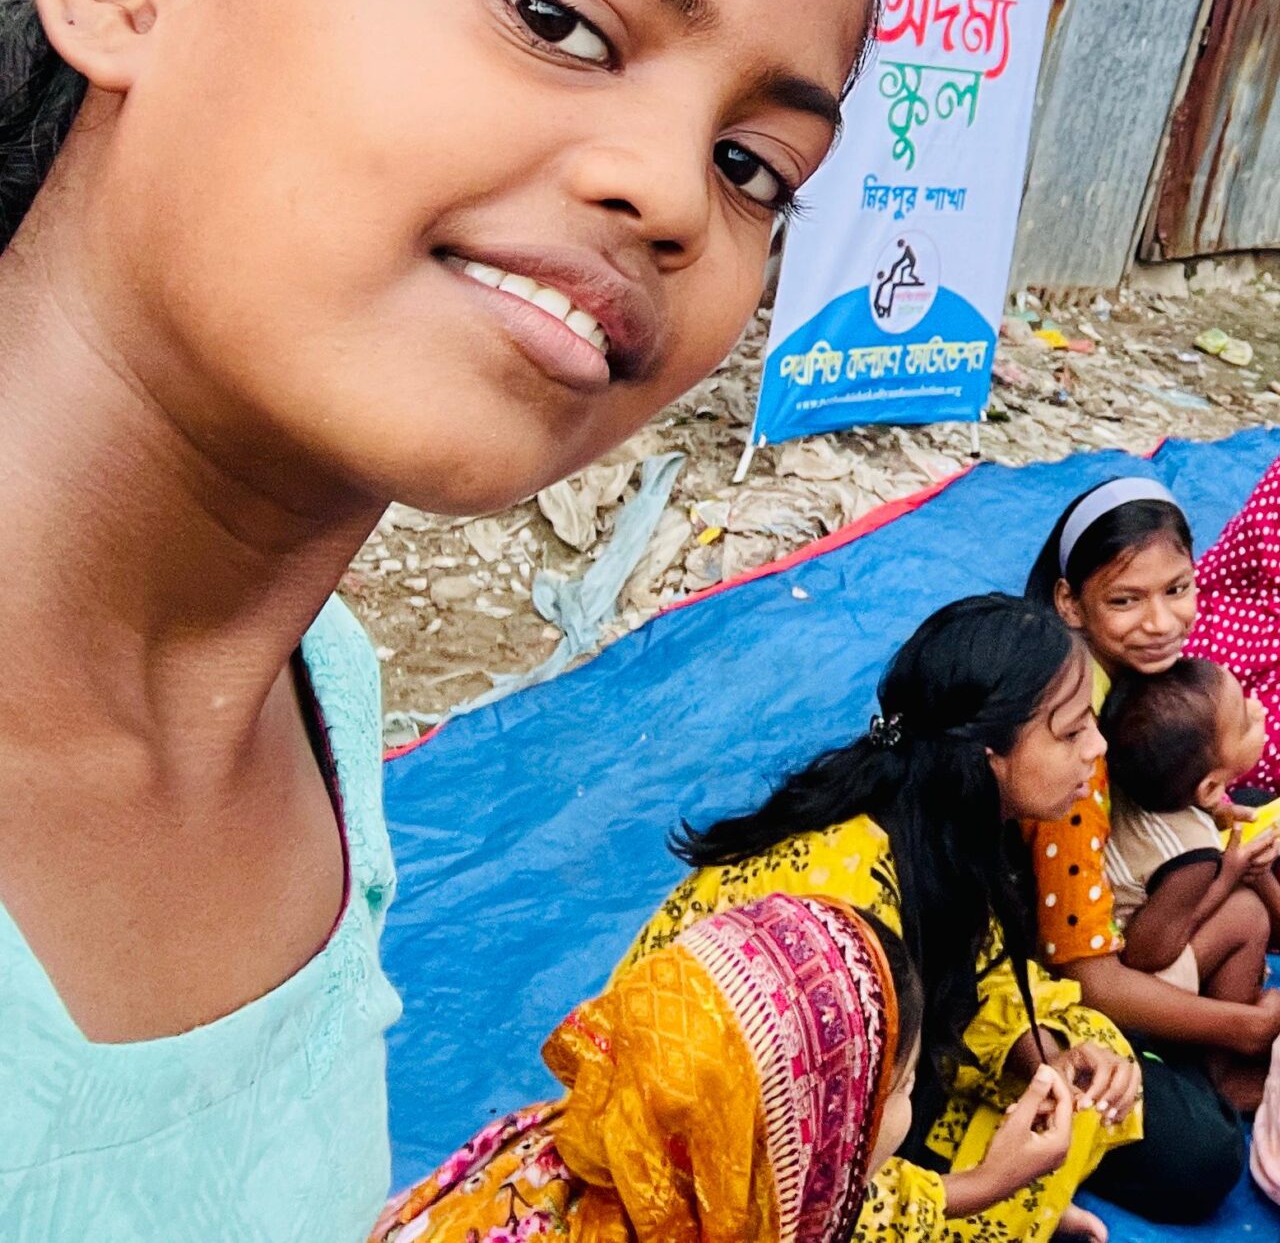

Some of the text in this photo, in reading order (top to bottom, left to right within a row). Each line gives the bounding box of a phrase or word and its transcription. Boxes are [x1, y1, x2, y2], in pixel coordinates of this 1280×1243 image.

[879, 60, 984, 172] স্কুল
[860, 173, 968, 221] মিরপুর শাখা
[780, 339, 844, 388] পথশিশু
[846, 344, 903, 380] কল্যাণ
